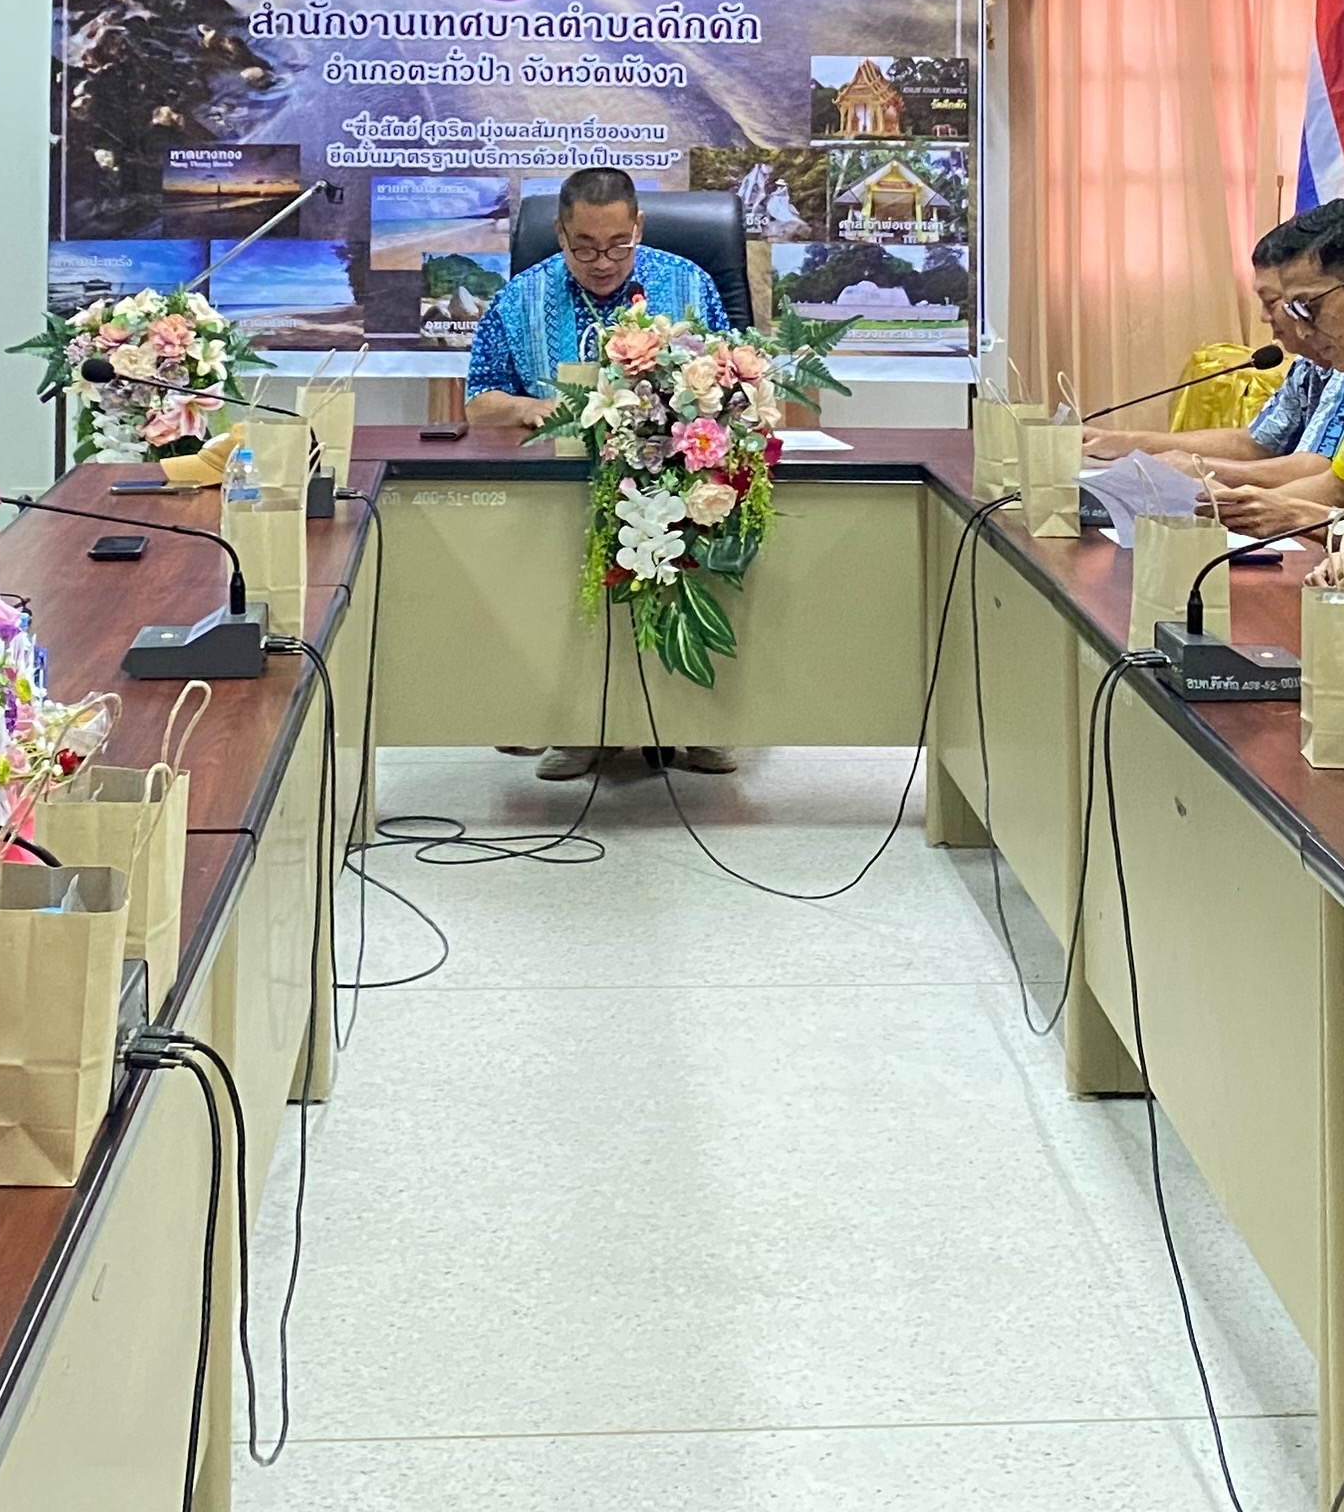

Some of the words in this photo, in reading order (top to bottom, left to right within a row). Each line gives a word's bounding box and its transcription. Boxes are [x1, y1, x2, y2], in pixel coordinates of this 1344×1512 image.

[251, 1, 759, 41] สำนักงานเทศบาลตำบลคึกคัก
[326, 48, 511, 83] อำเภอตะกั่วป่า
[521, 56, 685, 85] จังหวัดพังงา
[424, 120, 473, 143] สุจริต
[479, 117, 665, 143] มุ่งผลสัมฤทธิ์ของงาน
[330, 143, 467, 169] ยึดมั่นมาตรฐาน
